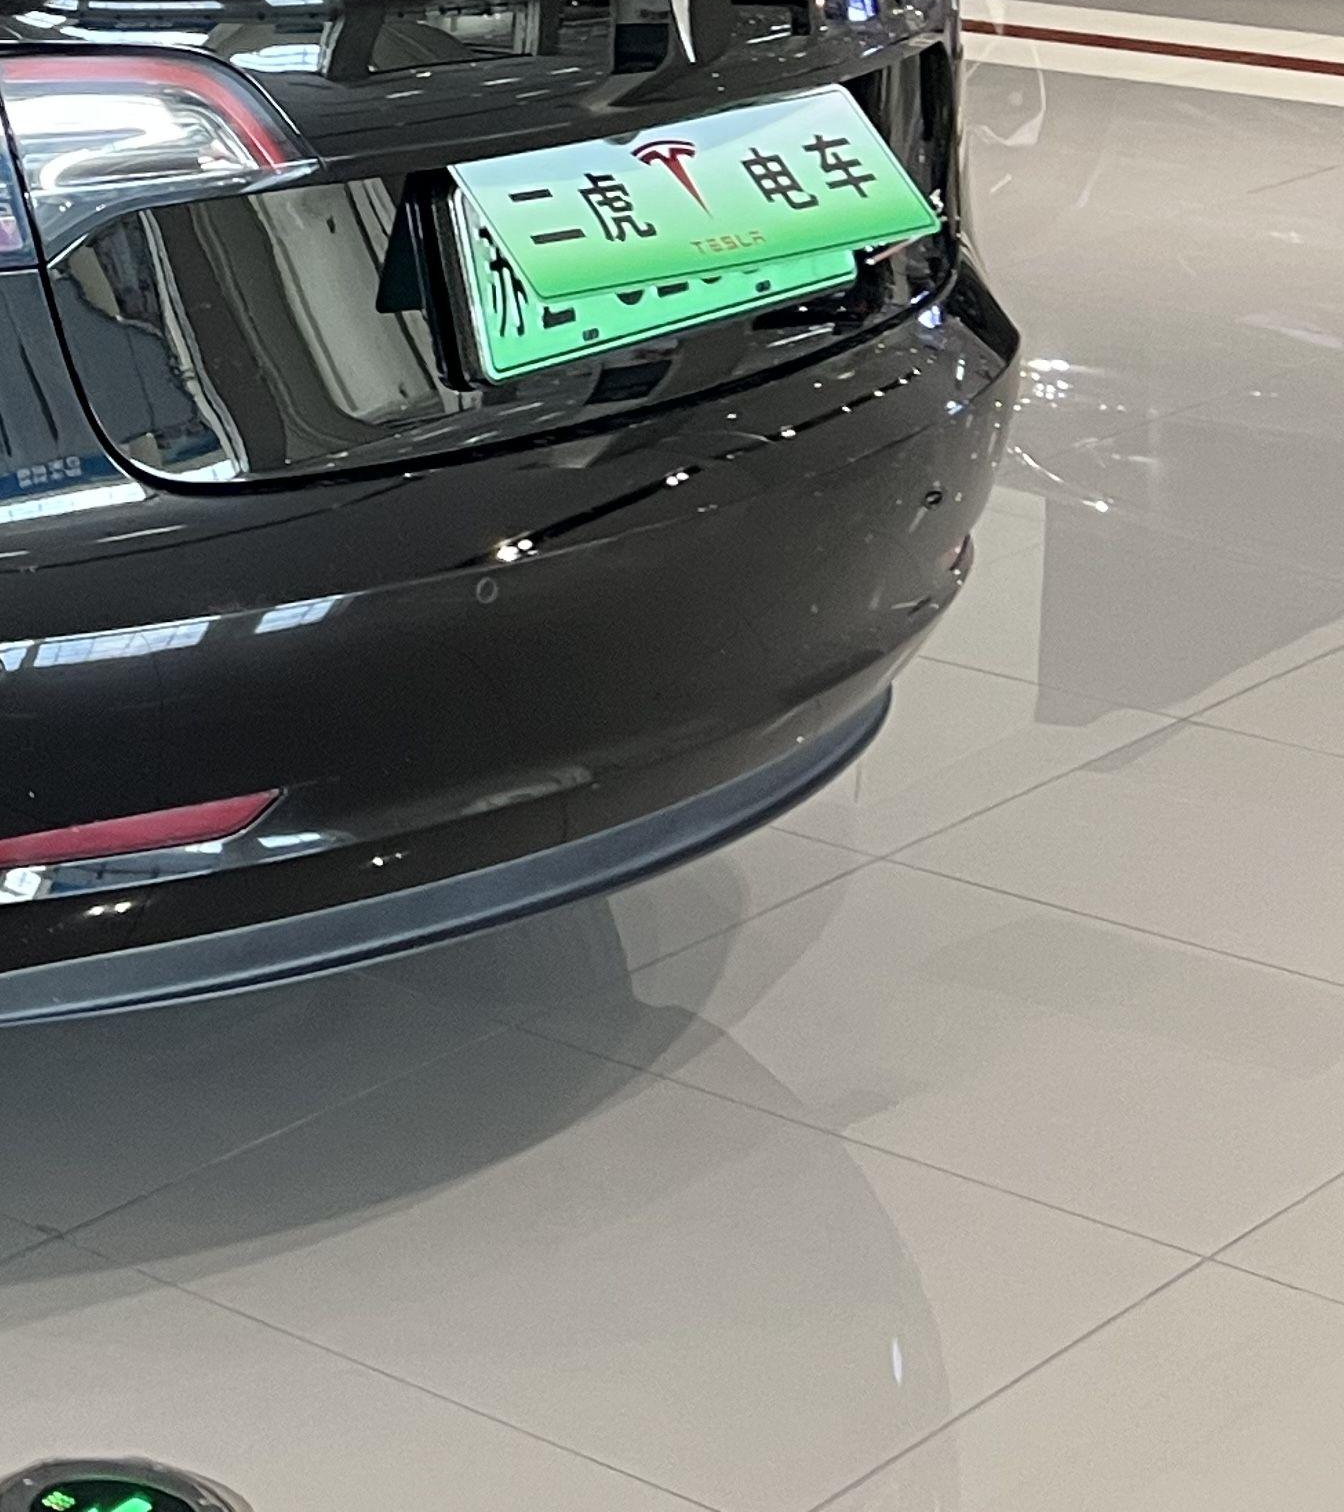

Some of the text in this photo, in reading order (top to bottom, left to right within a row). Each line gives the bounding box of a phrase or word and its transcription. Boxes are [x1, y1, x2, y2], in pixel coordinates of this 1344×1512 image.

[509, 134, 877, 244] 二虎 电车
[691, 230, 766, 255] TESLA
